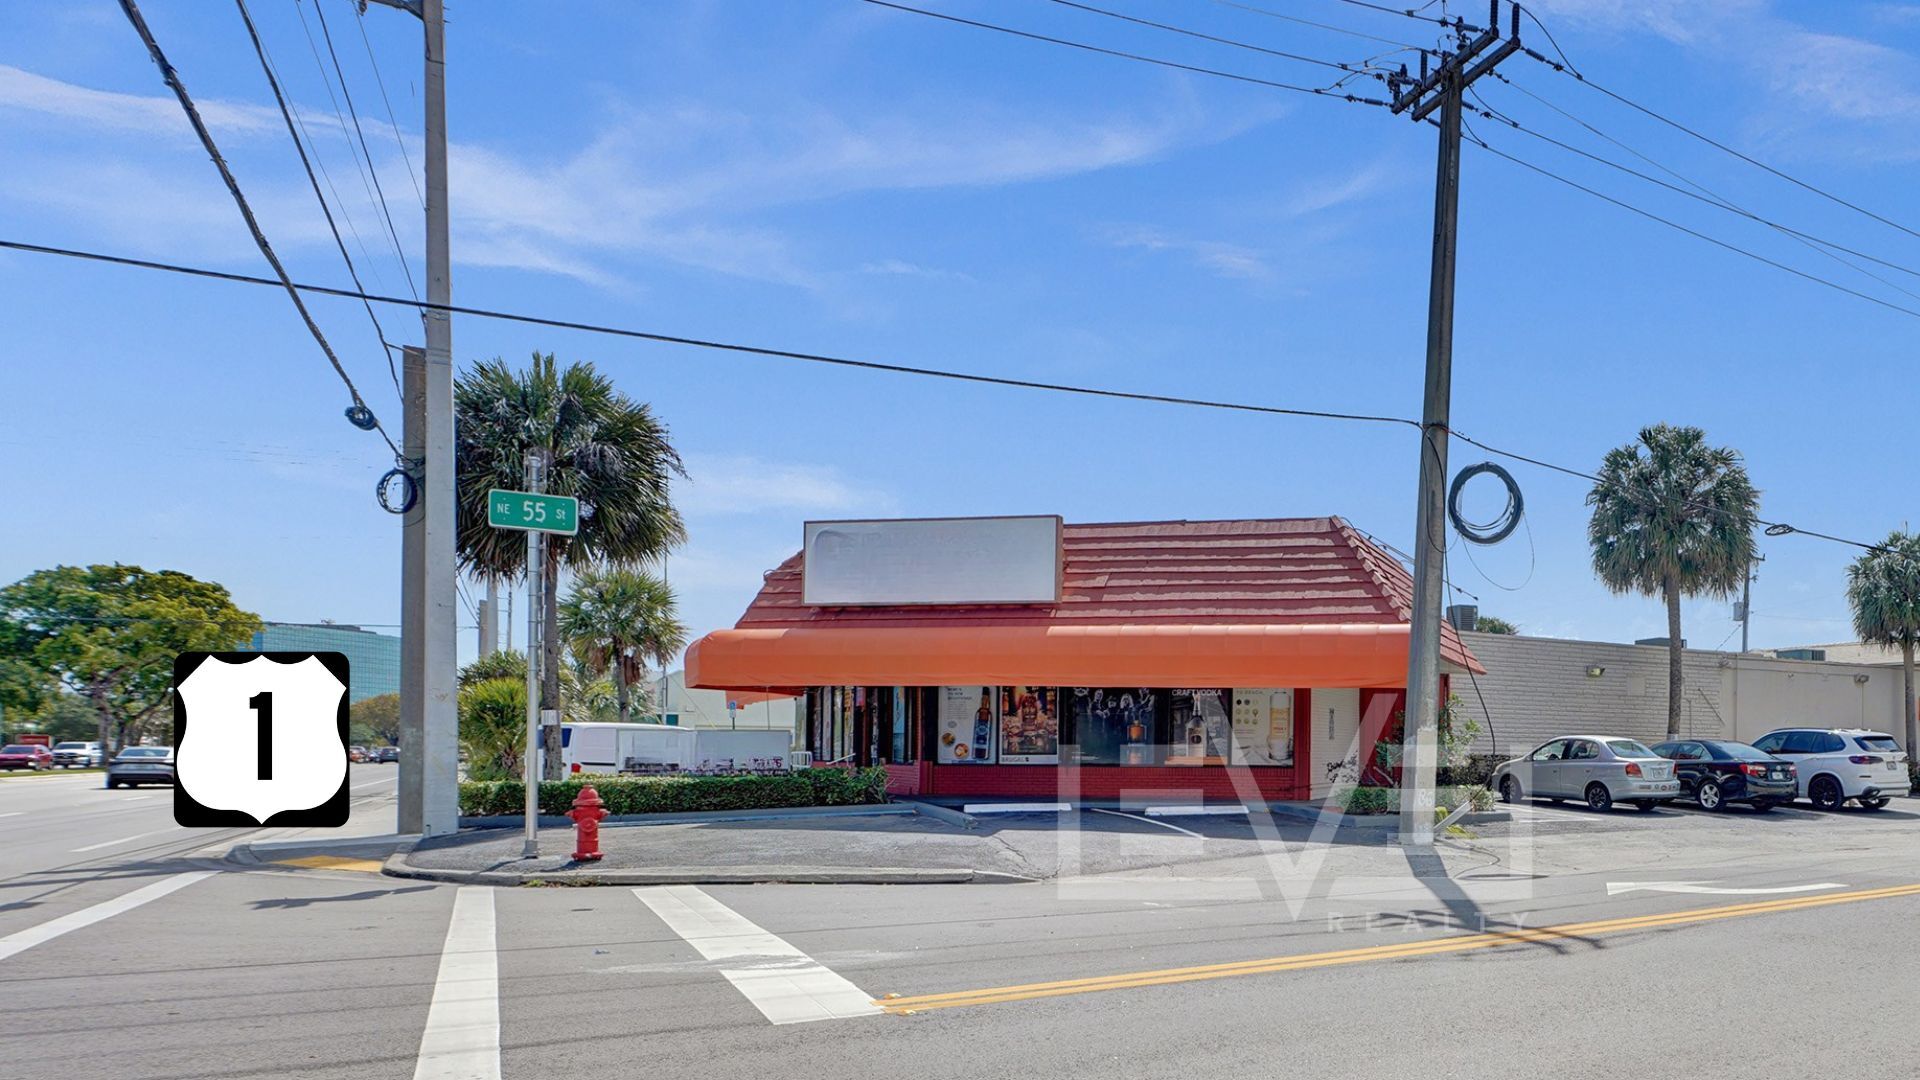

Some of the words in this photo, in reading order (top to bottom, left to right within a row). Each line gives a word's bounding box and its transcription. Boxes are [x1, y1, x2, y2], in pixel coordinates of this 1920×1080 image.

[497, 503, 510, 514] NE
[523, 500, 546, 522] 55
[556, 509, 566, 520] St
[1171, 688, 1194, 696] CRAFT
[1196, 688, 1222, 697] VODKA
